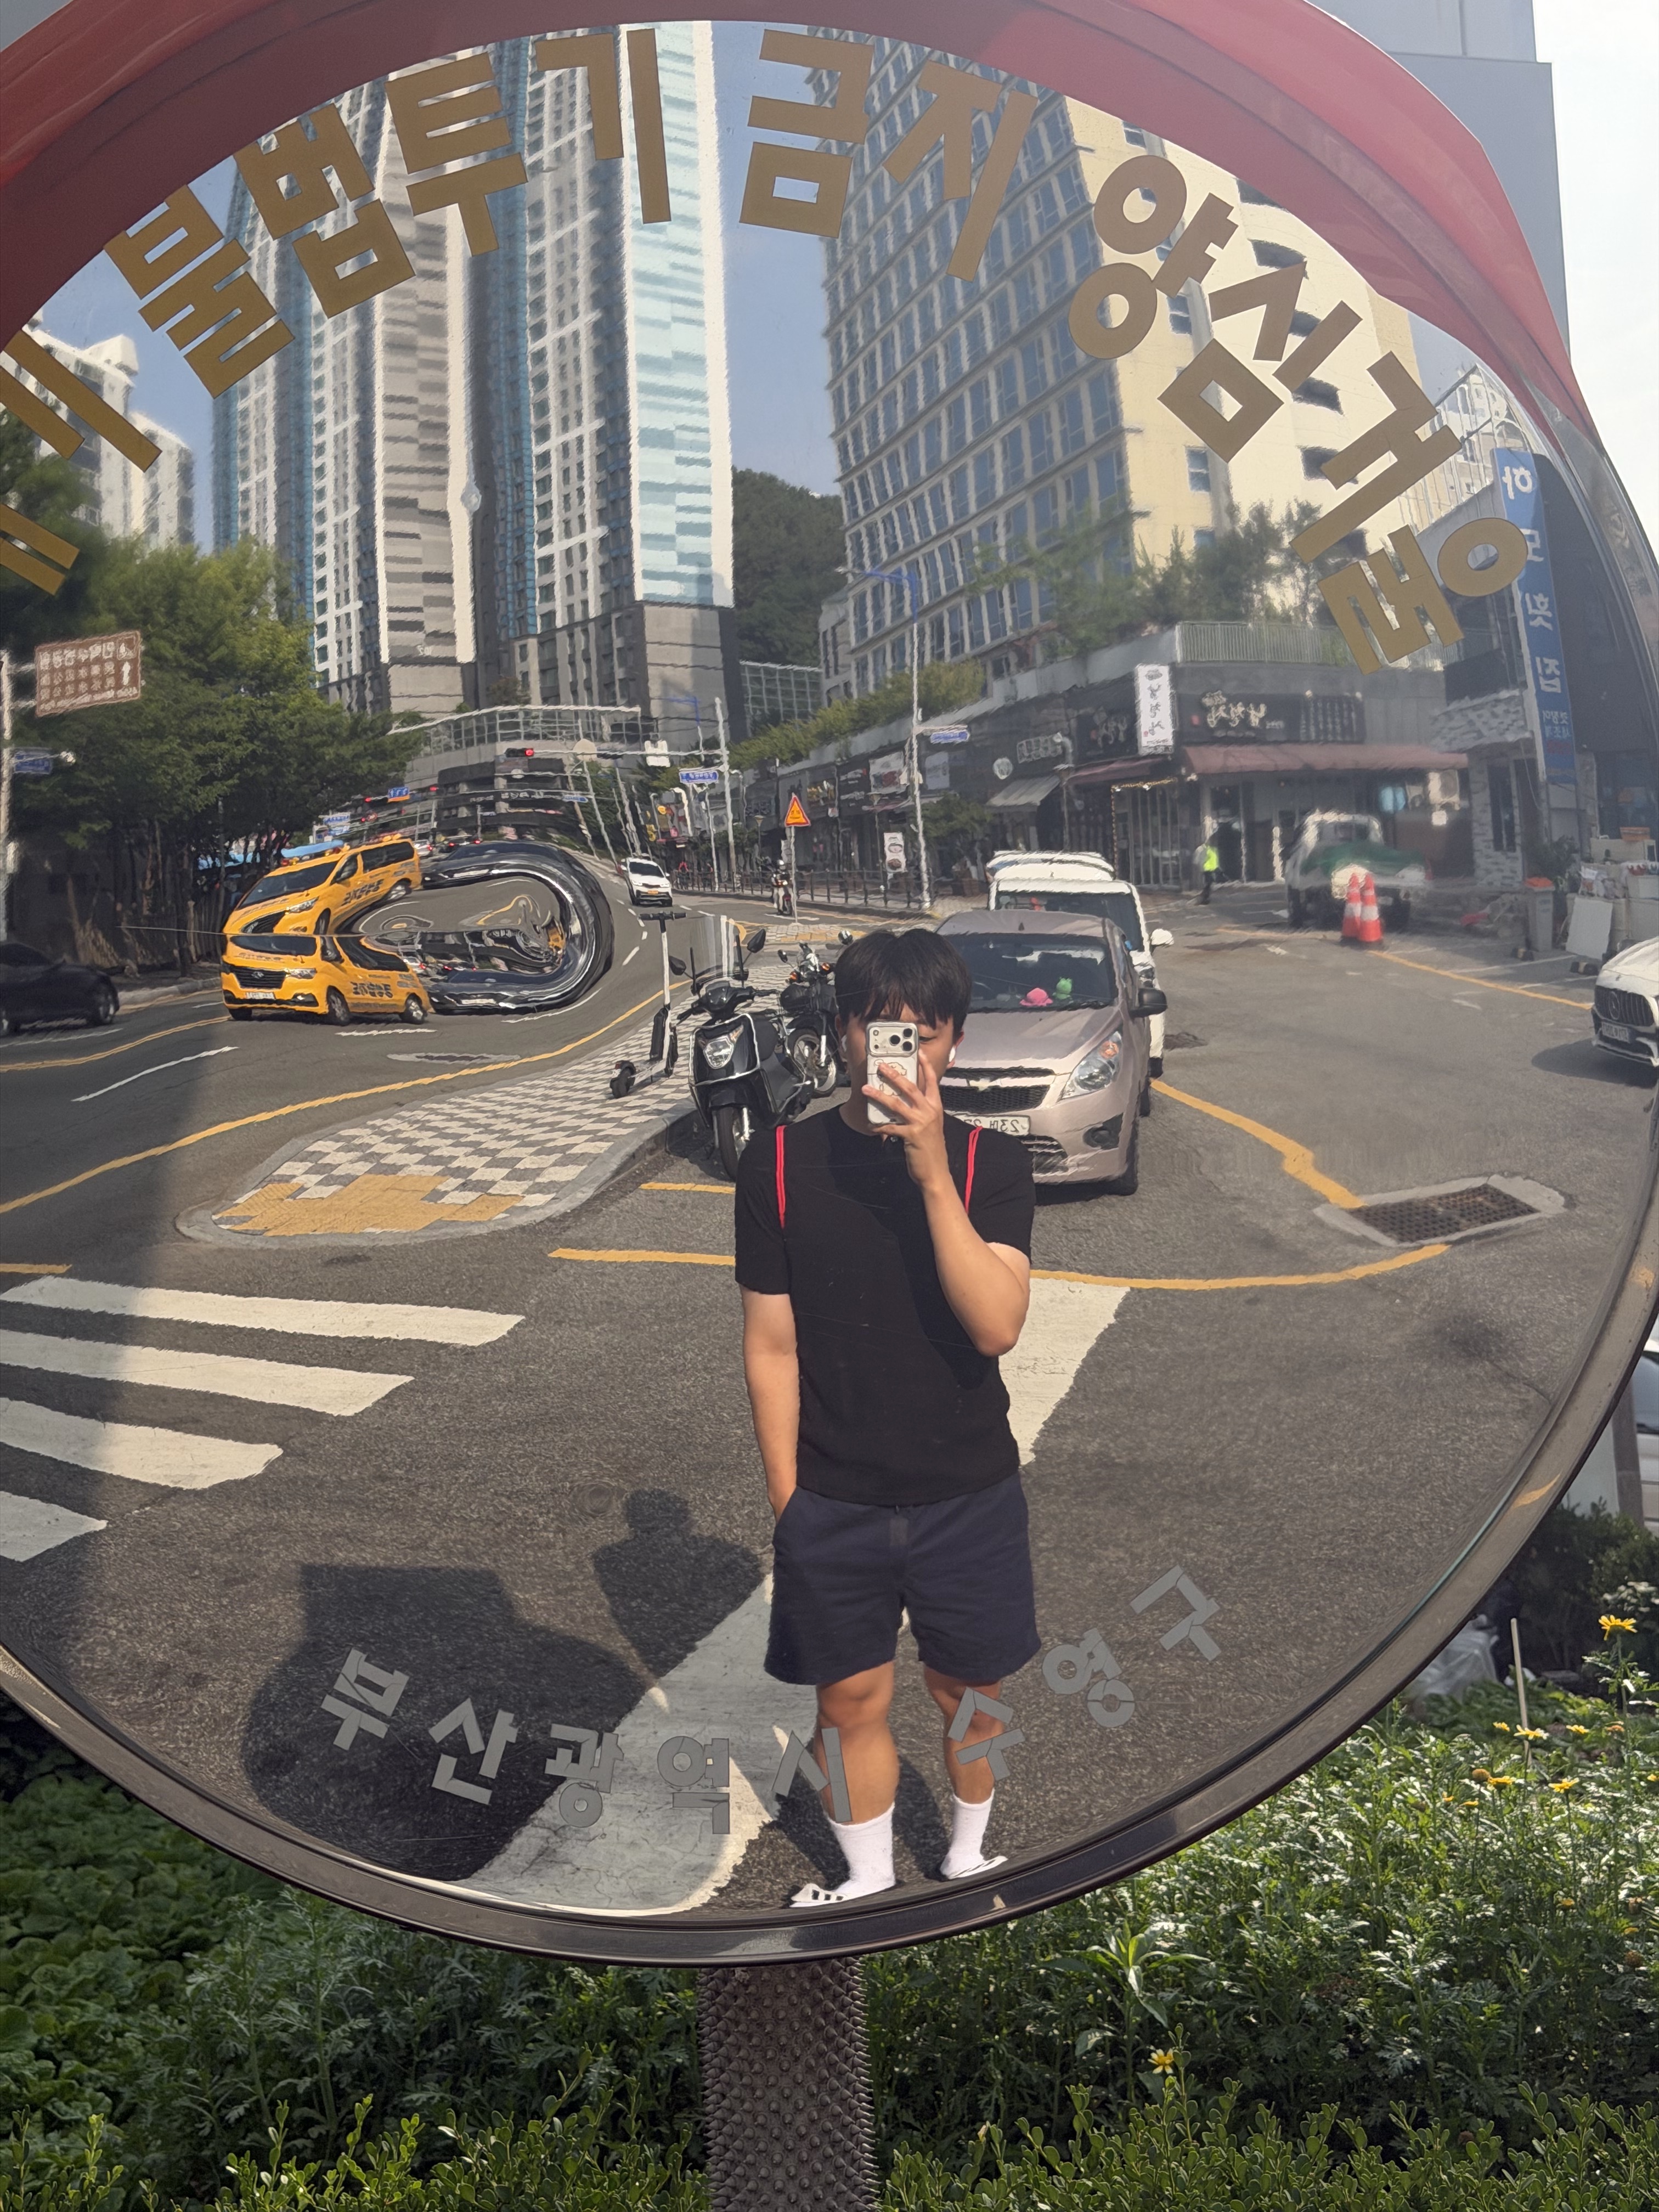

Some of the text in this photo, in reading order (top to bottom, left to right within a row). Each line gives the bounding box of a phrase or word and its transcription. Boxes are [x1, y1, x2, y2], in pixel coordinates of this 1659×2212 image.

[103, 29, 672, 399] 불법투기
[739, 29, 1039, 283] 금지
[1068, 155, 1528, 675] 양심거울
[320, 1565, 1221, 1834] 부산광역시 수영구
